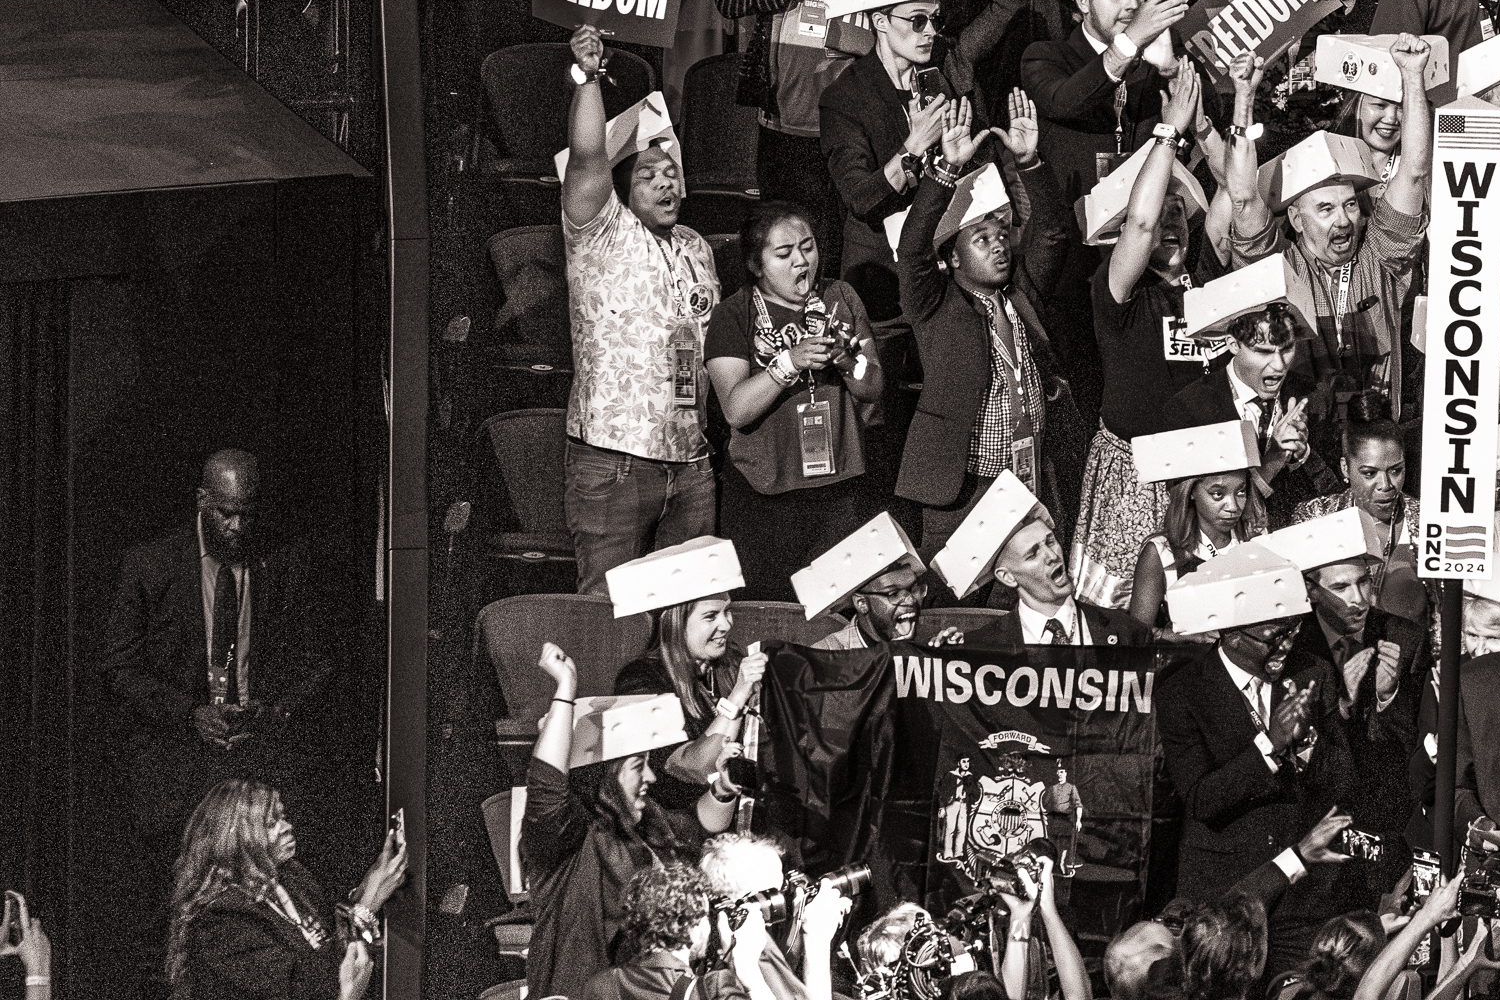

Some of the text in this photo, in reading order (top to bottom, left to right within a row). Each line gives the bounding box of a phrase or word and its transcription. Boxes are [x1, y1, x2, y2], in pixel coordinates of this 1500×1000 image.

[1341, 262, 1351, 284] DNC
[1441, 161, 1497, 513] WISCONSIN
[1206, 543, 1218, 558] DN
[1425, 524, 1485, 573] DNC 2024
[894, 655, 1156, 714] WISCONSIN
[993, 731, 1033, 744] FORWARD
